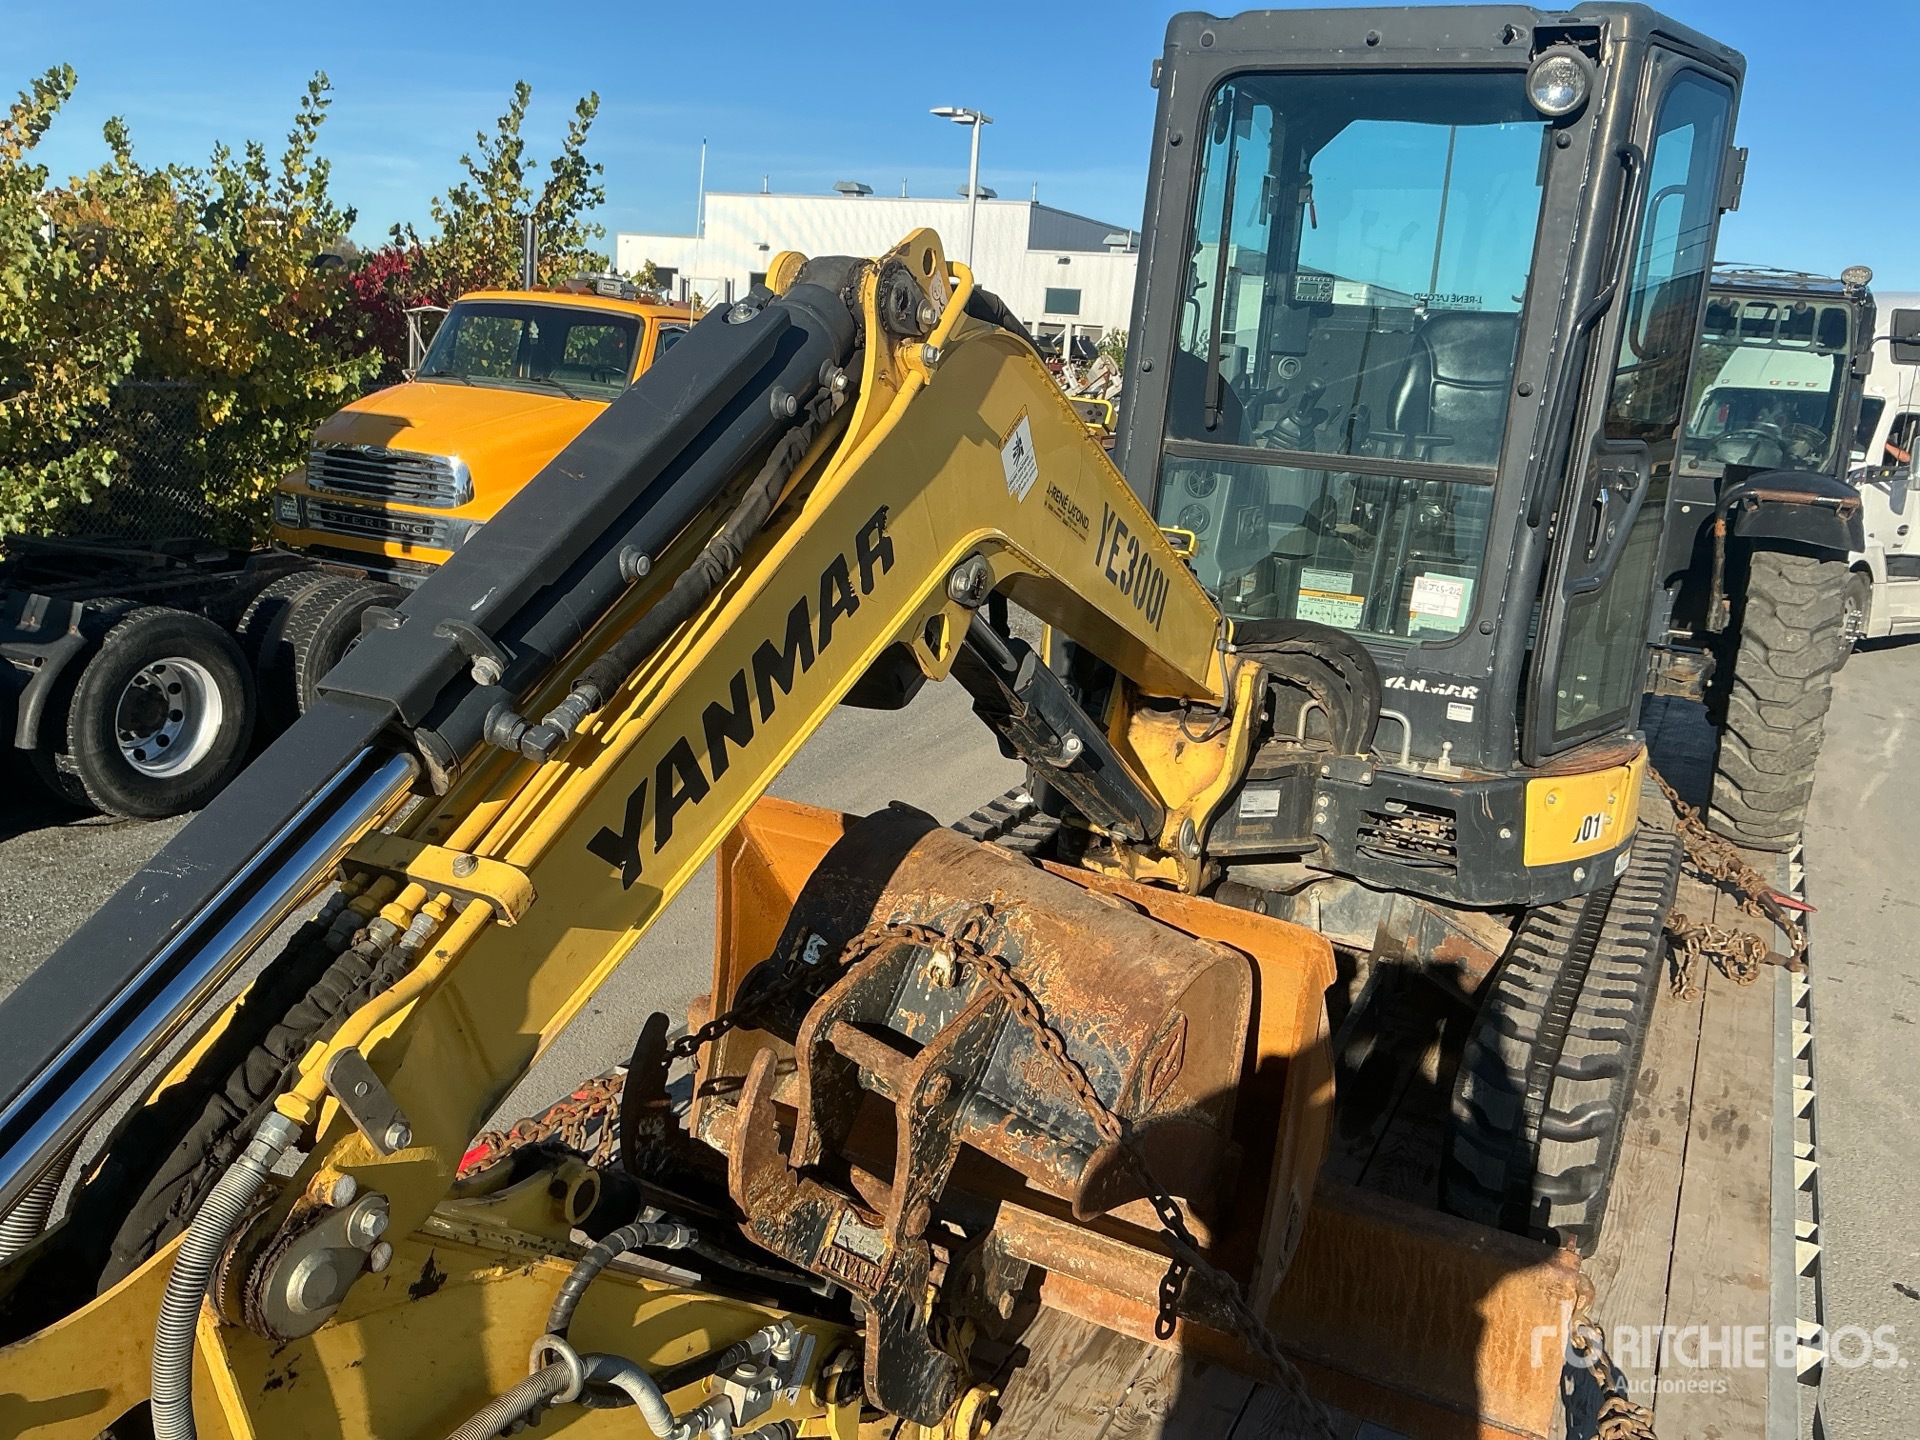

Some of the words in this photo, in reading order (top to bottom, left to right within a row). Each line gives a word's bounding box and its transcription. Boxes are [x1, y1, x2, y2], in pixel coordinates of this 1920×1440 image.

[327, 512, 424, 534] STERLING
[1307, 597, 1335, 605] OPERATING
[586, 504, 896, 891] YANMAR
